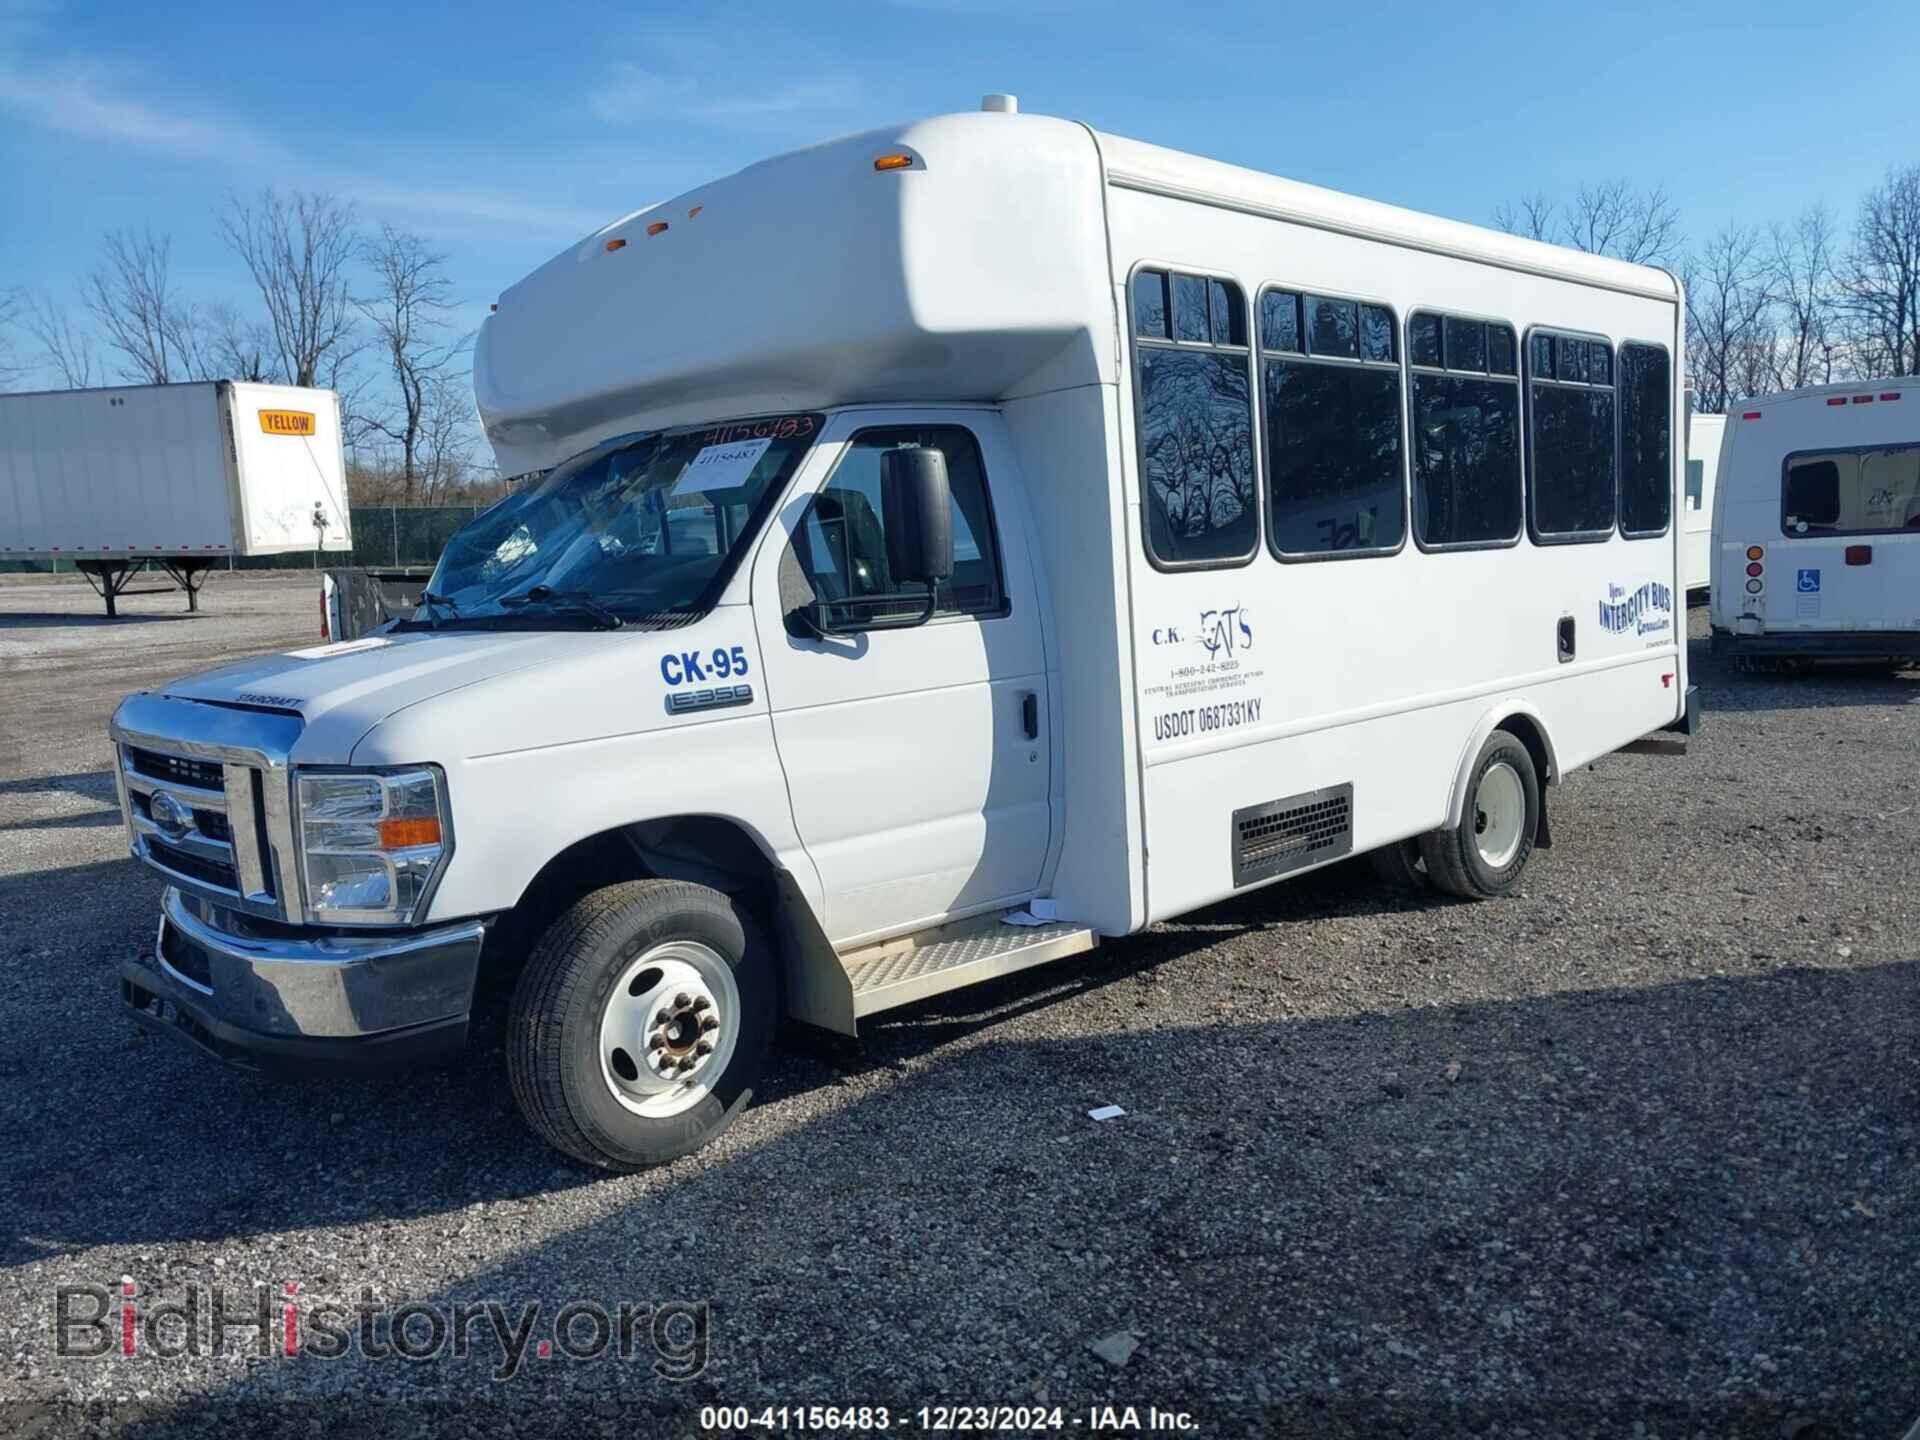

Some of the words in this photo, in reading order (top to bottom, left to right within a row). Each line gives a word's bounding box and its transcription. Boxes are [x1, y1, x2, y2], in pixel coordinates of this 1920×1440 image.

[266, 414, 309, 431] YELLOW
[1599, 583, 1649, 633] INTERCITY
[1652, 582, 1671, 612] BUS
[1152, 627, 1185, 645] C.K.
[661, 646, 748, 686] CK-95
[1154, 709, 1195, 740] USDOT
[1200, 698, 1261, 732] 0687331KY
